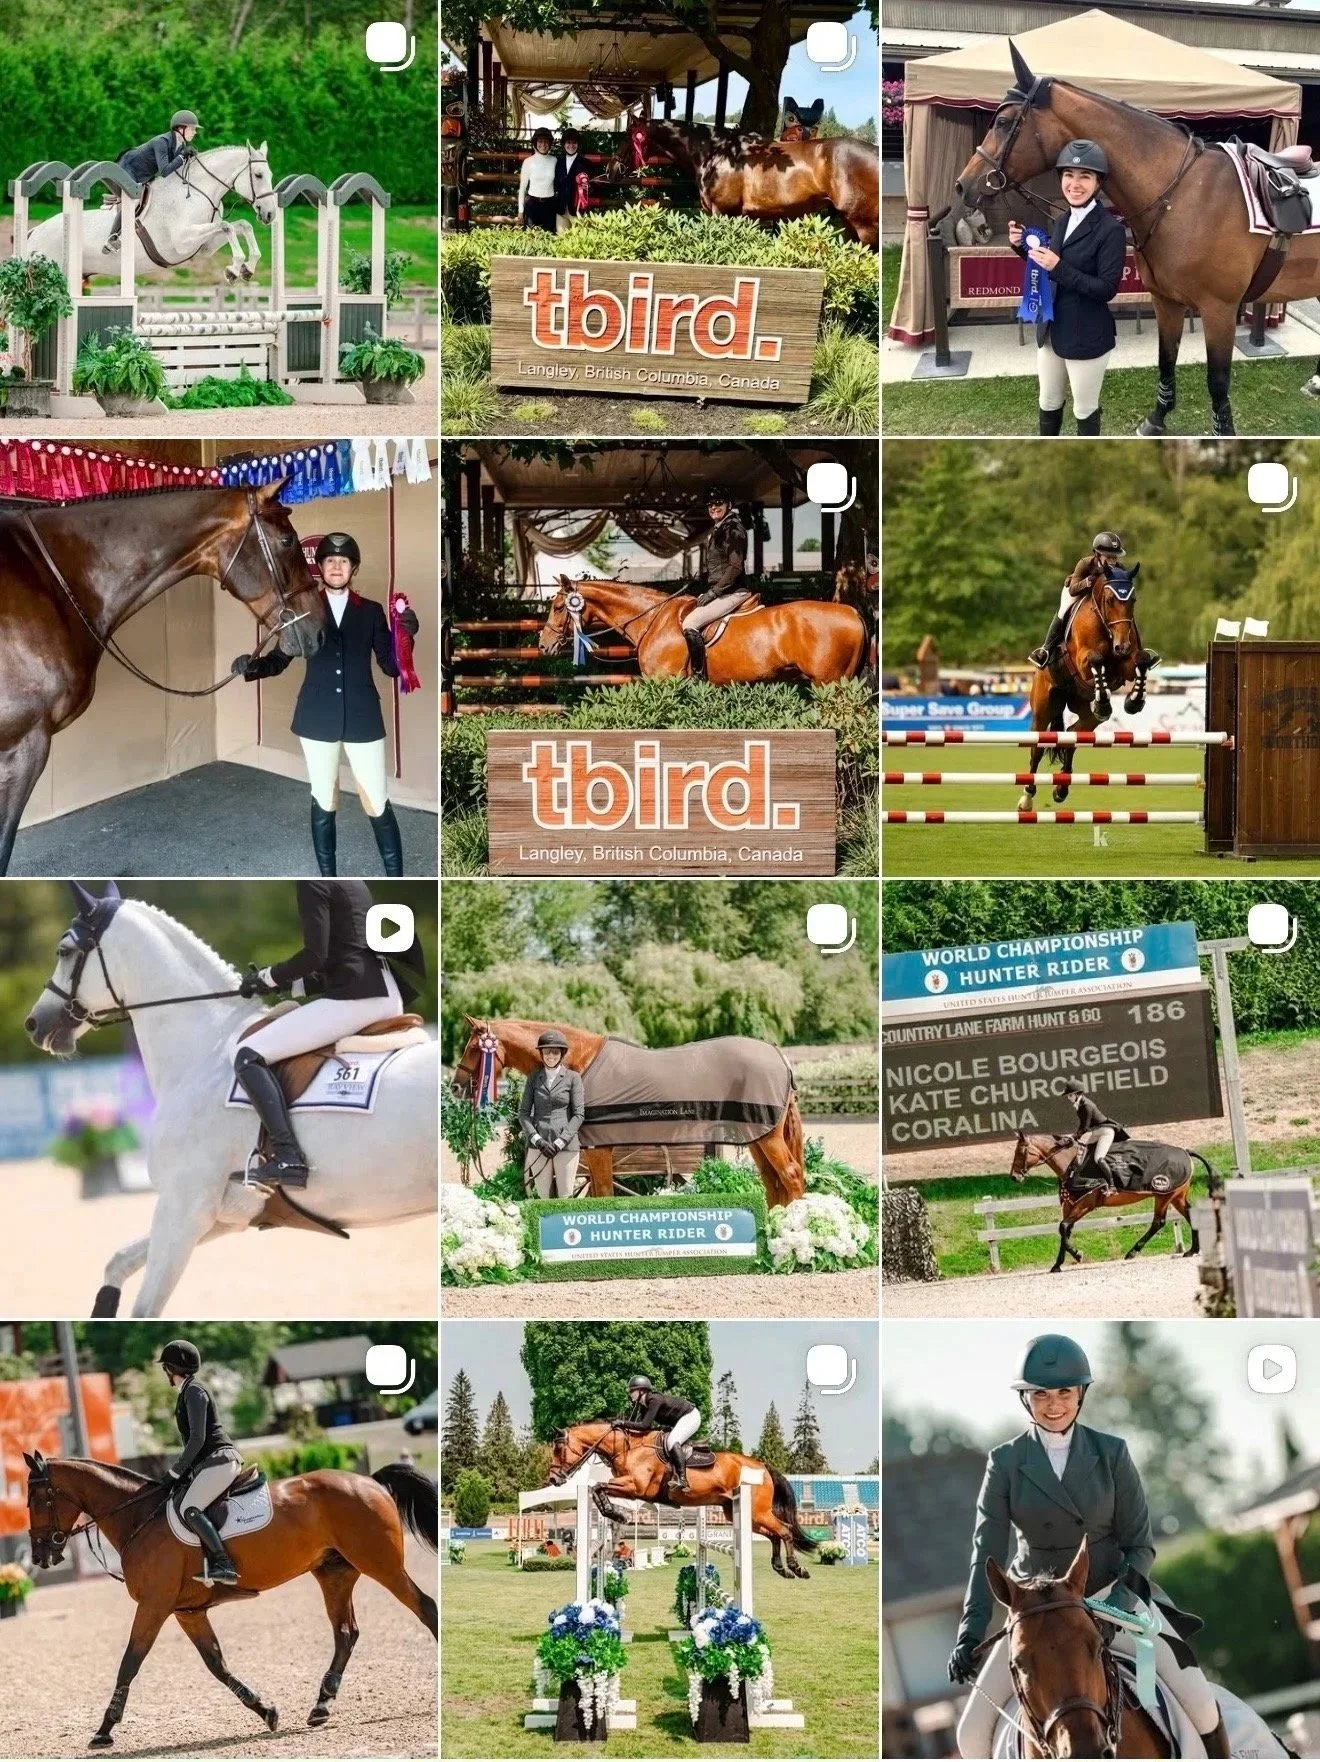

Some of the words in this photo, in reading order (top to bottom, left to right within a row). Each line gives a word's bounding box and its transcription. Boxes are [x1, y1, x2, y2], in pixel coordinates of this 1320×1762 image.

[968, 287, 1021, 296] REDMOND
[523, 267, 783, 362] tbird.
[518, 361, 579, 379] Langley,
[584, 365, 631, 381] British
[636, 368, 713, 388] Columbia,
[718, 373, 780, 391] Canada
[927, 701, 965, 717] Save
[967, 701, 1016, 718] Group
[522, 740, 801, 832] tbird.
[519, 845, 587, 863] Langley,
[592, 846, 644, 862] British
[649, 847, 732, 863] Columbia,
[738, 847, 803, 862] Canada
[922, 946, 990, 967] WORLD
[996, 929, 1144, 959] CHAMPIONSHIP
[959, 963, 1040, 986] HUNTER
[1048, 956, 1110, 976] RIDER
[943, 1000, 978, 1009] UNITED
[979, 997, 1008, 1006] STATES
[1078, 981, 1133, 996] ASSOCIATION
[946, 1018, 984, 1038] LANE
[985, 1012, 1025, 1034] FARM
[1029, 1008, 1067, 1029] HUNT
[1068, 1009, 1080, 1024] &
[1081, 1006, 1101, 1022] GO
[1127, 1000, 1187, 1025] 186
[333, 1067, 360, 1081] 561
[886, 1057, 990, 1088] NICOLE
[1000, 1038, 1167, 1076] BOURGEOIS
[889, 1087, 963, 1115] KATE
[891, 1108, 1039, 1142] CORALINA
[562, 1213, 616, 1226] WORLD
[619, 1211, 733, 1225] CHAMPIONSHIP
[590, 1228, 652, 1241] HUNTER
[658, 1227, 706, 1240] RIDER
[571, 1252, 599, 1260] UNITED
[600, 1251, 623, 1259] STATES
[683, 1248, 728, 1257] ASSOCIATION
[855, 1522, 868, 1557] ATCO
